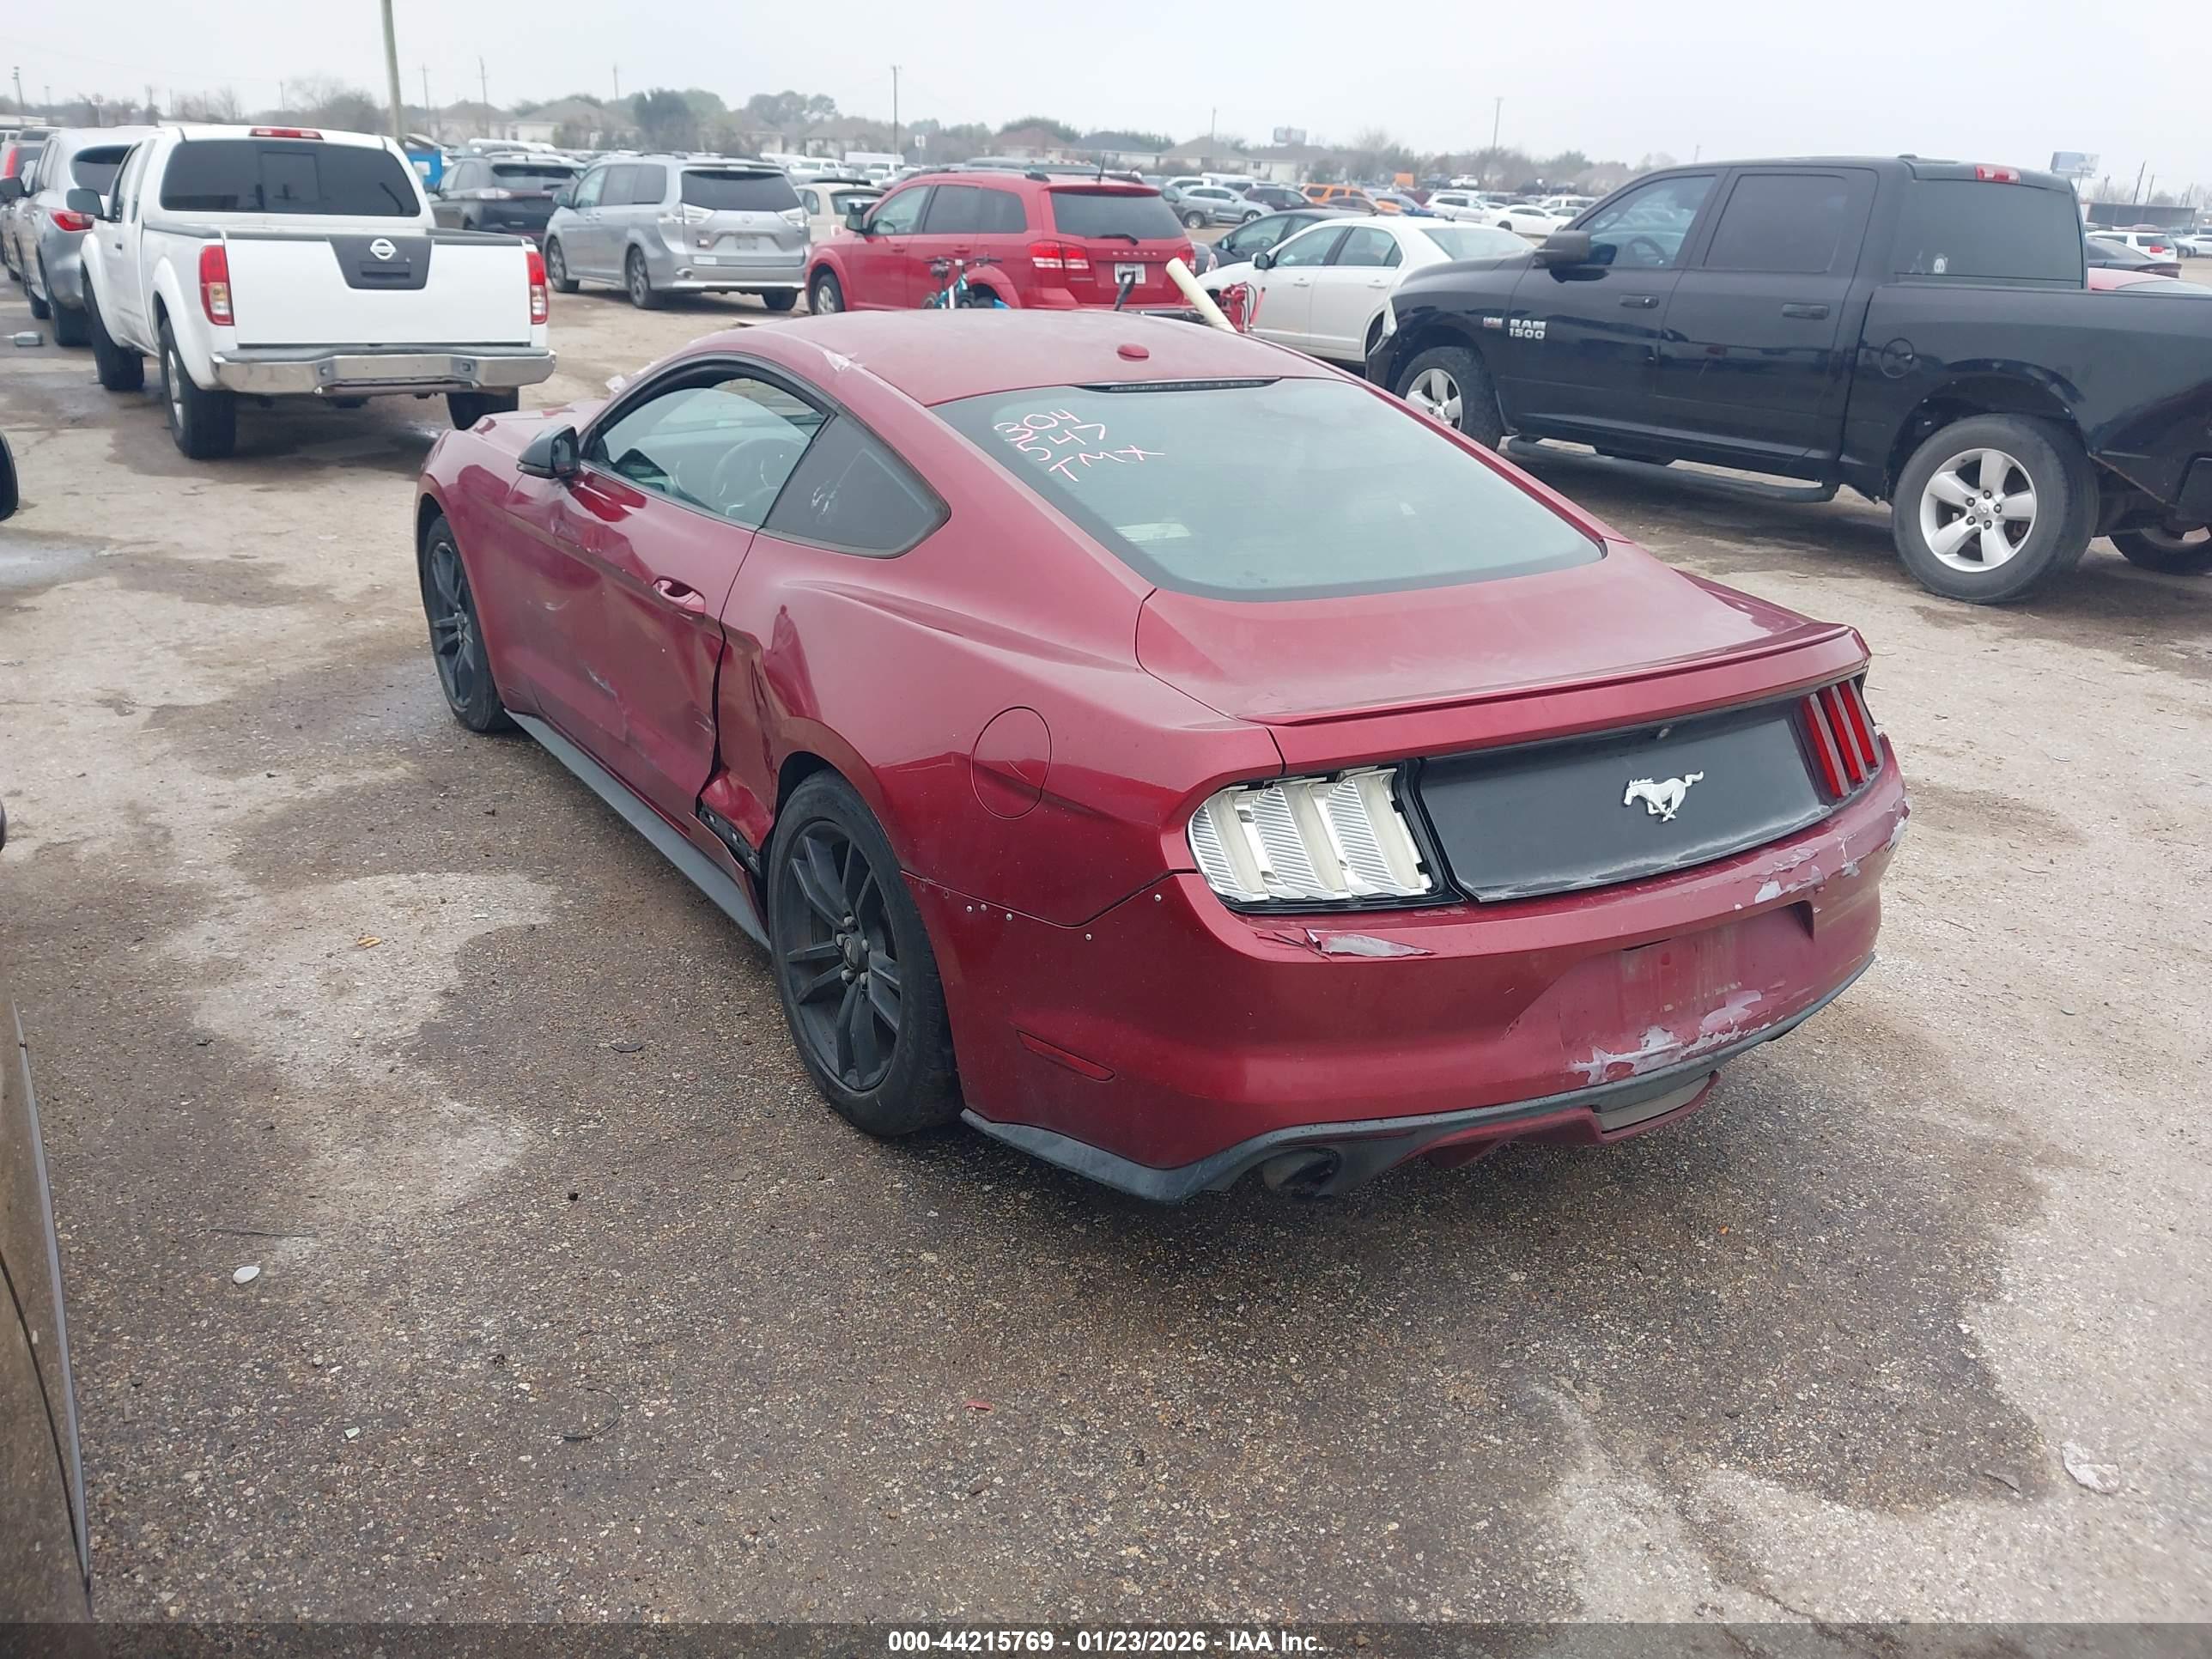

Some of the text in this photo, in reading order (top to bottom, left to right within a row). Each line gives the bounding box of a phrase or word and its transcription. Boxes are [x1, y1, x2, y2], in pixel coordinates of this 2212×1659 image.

[1509, 328, 1546, 339] 1500
[1510, 319, 1547, 330] RAM
[994, 409, 1082, 441] 304
[1016, 422, 1106, 462] 547
[1048, 444, 1166, 483] TMX
